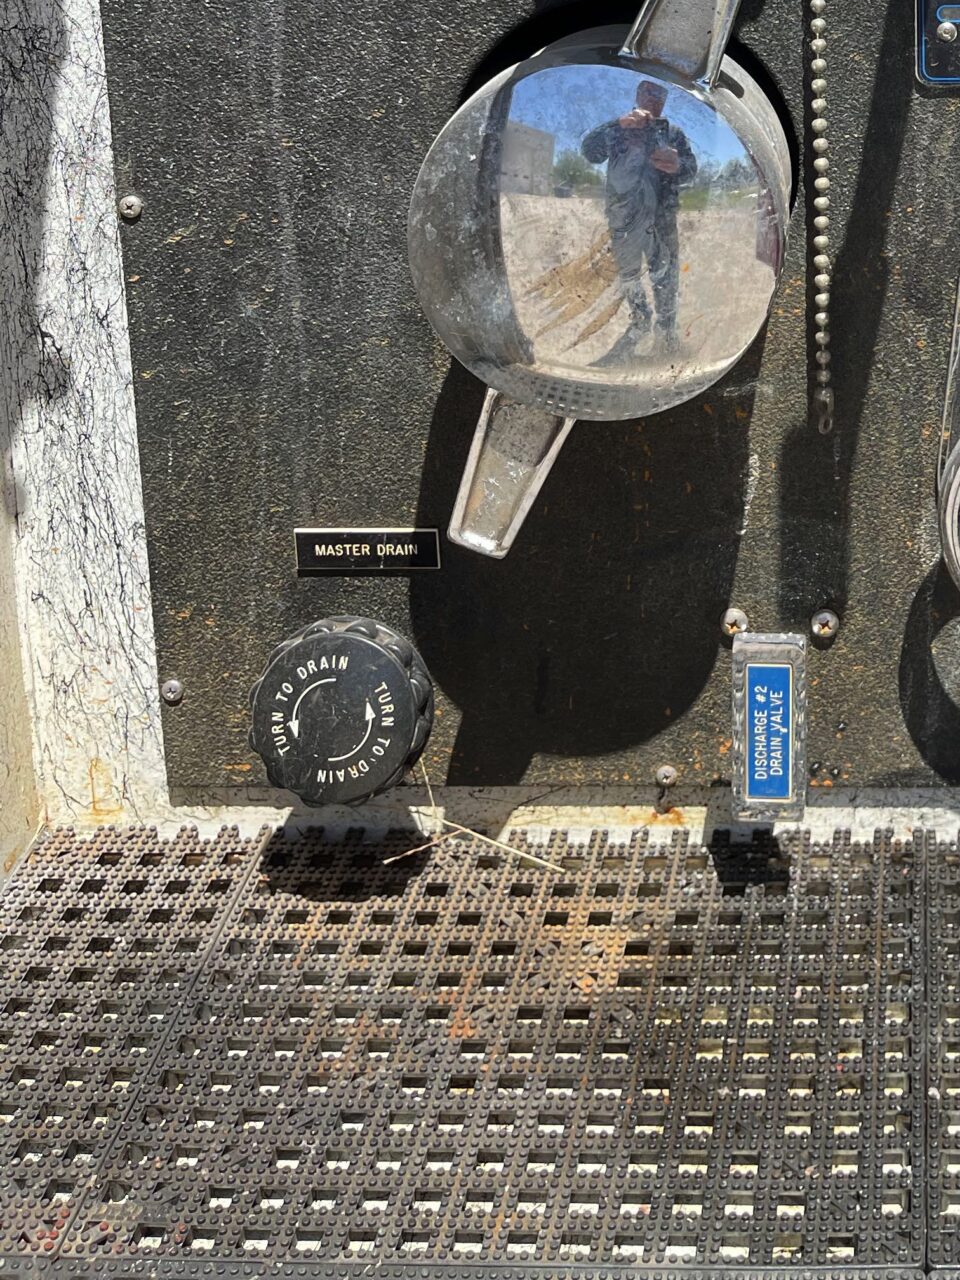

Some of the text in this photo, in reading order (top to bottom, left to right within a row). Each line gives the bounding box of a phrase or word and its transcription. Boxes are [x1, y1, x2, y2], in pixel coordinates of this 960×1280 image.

[315, 544, 418, 556] MASTER DRAIN
[271, 654, 349, 757] TURN TO DRAIN
[316, 681, 394, 784] TURN TO DRAIN
[754, 685, 768, 780] DISCHARGE #2
[770, 690, 784, 776] DRAIN VALVE
